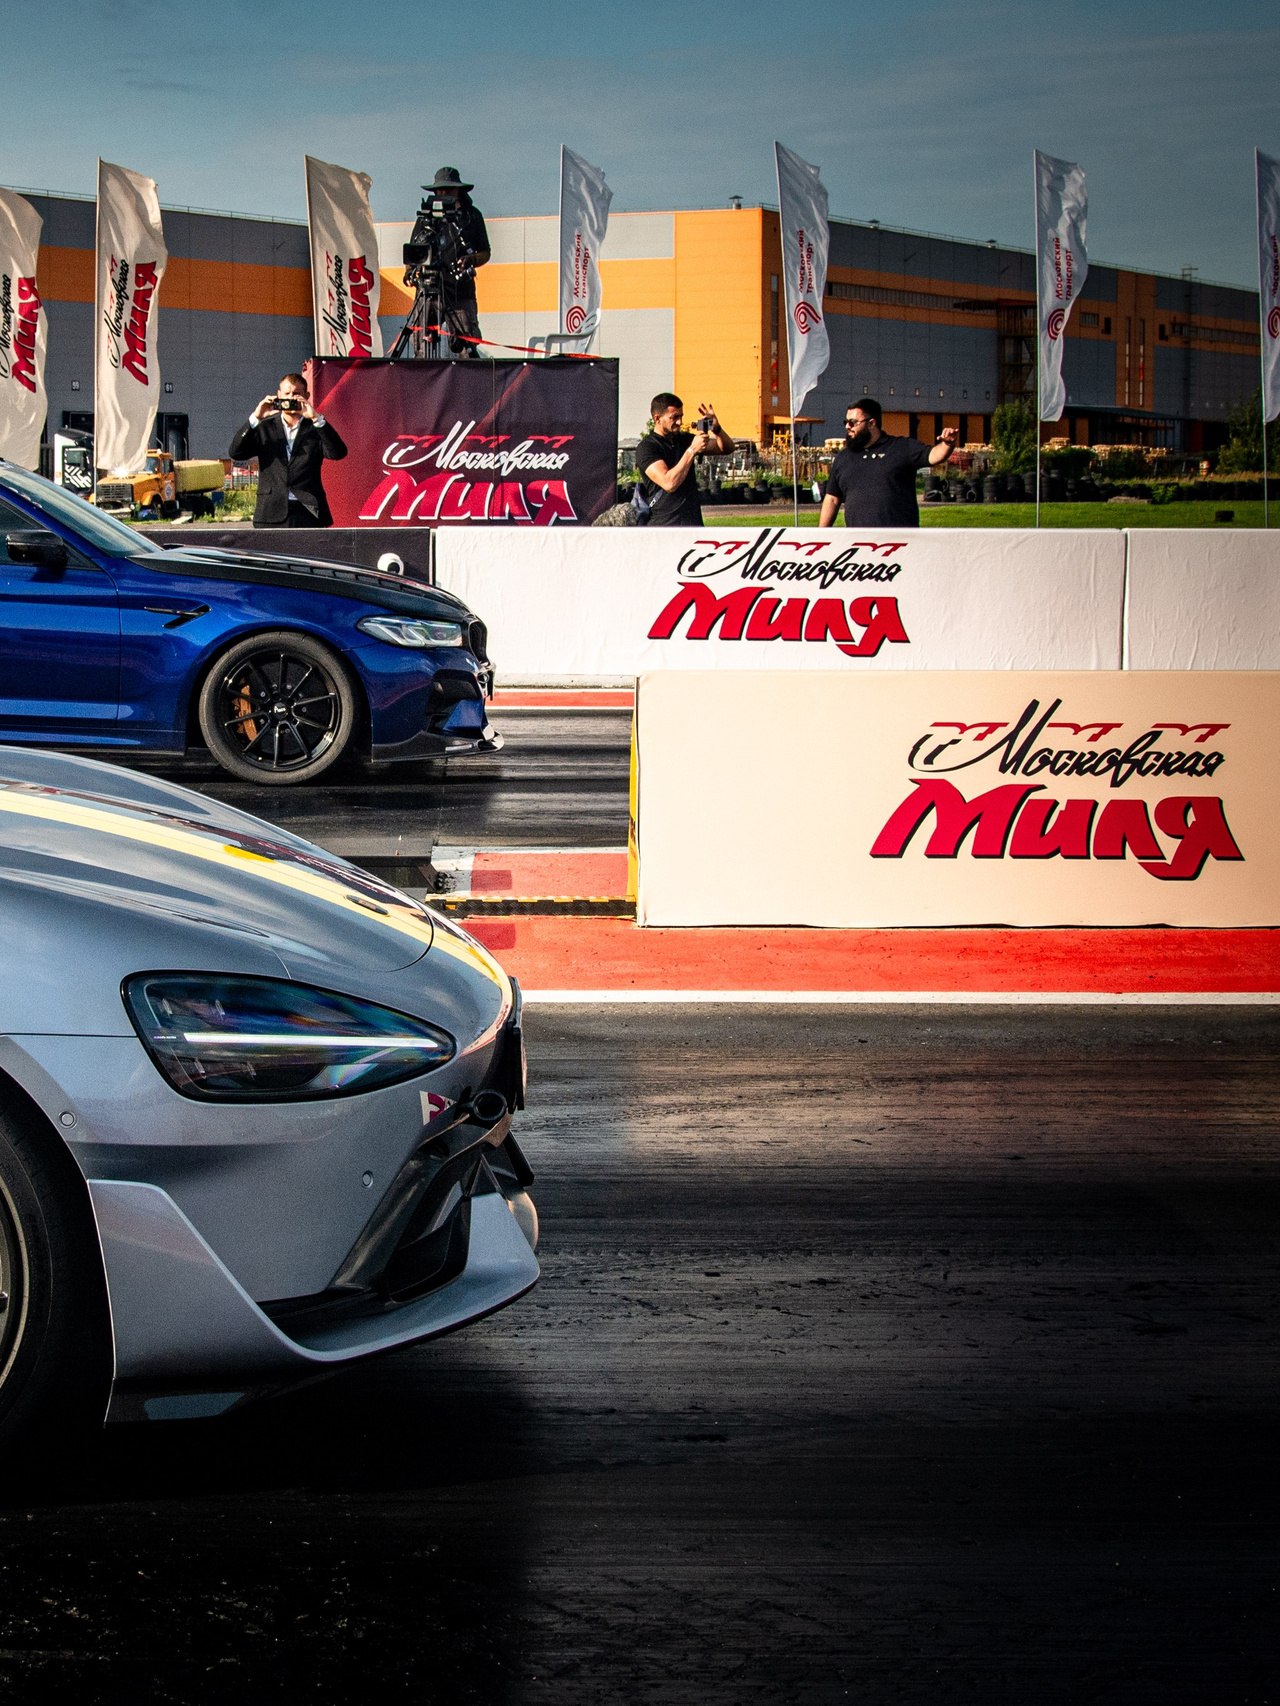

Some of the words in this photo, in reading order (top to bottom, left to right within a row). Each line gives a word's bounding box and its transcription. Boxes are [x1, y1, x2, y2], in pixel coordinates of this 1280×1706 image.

[581, 246, 591, 299] транспорт
[1053, 237, 1062, 300] Московский
[1065, 249, 1073, 301] транспорт
[11, 276, 43, 394] Миля
[122, 260, 158, 386] Миля
[382, 420, 570, 476] Московская
[358, 470, 578, 526] Миля
[677, 528, 902, 590] Московская
[646, 581, 911, 658] Миля
[907, 698, 1225, 788] Московская
[869, 778, 1245, 881] Миля
